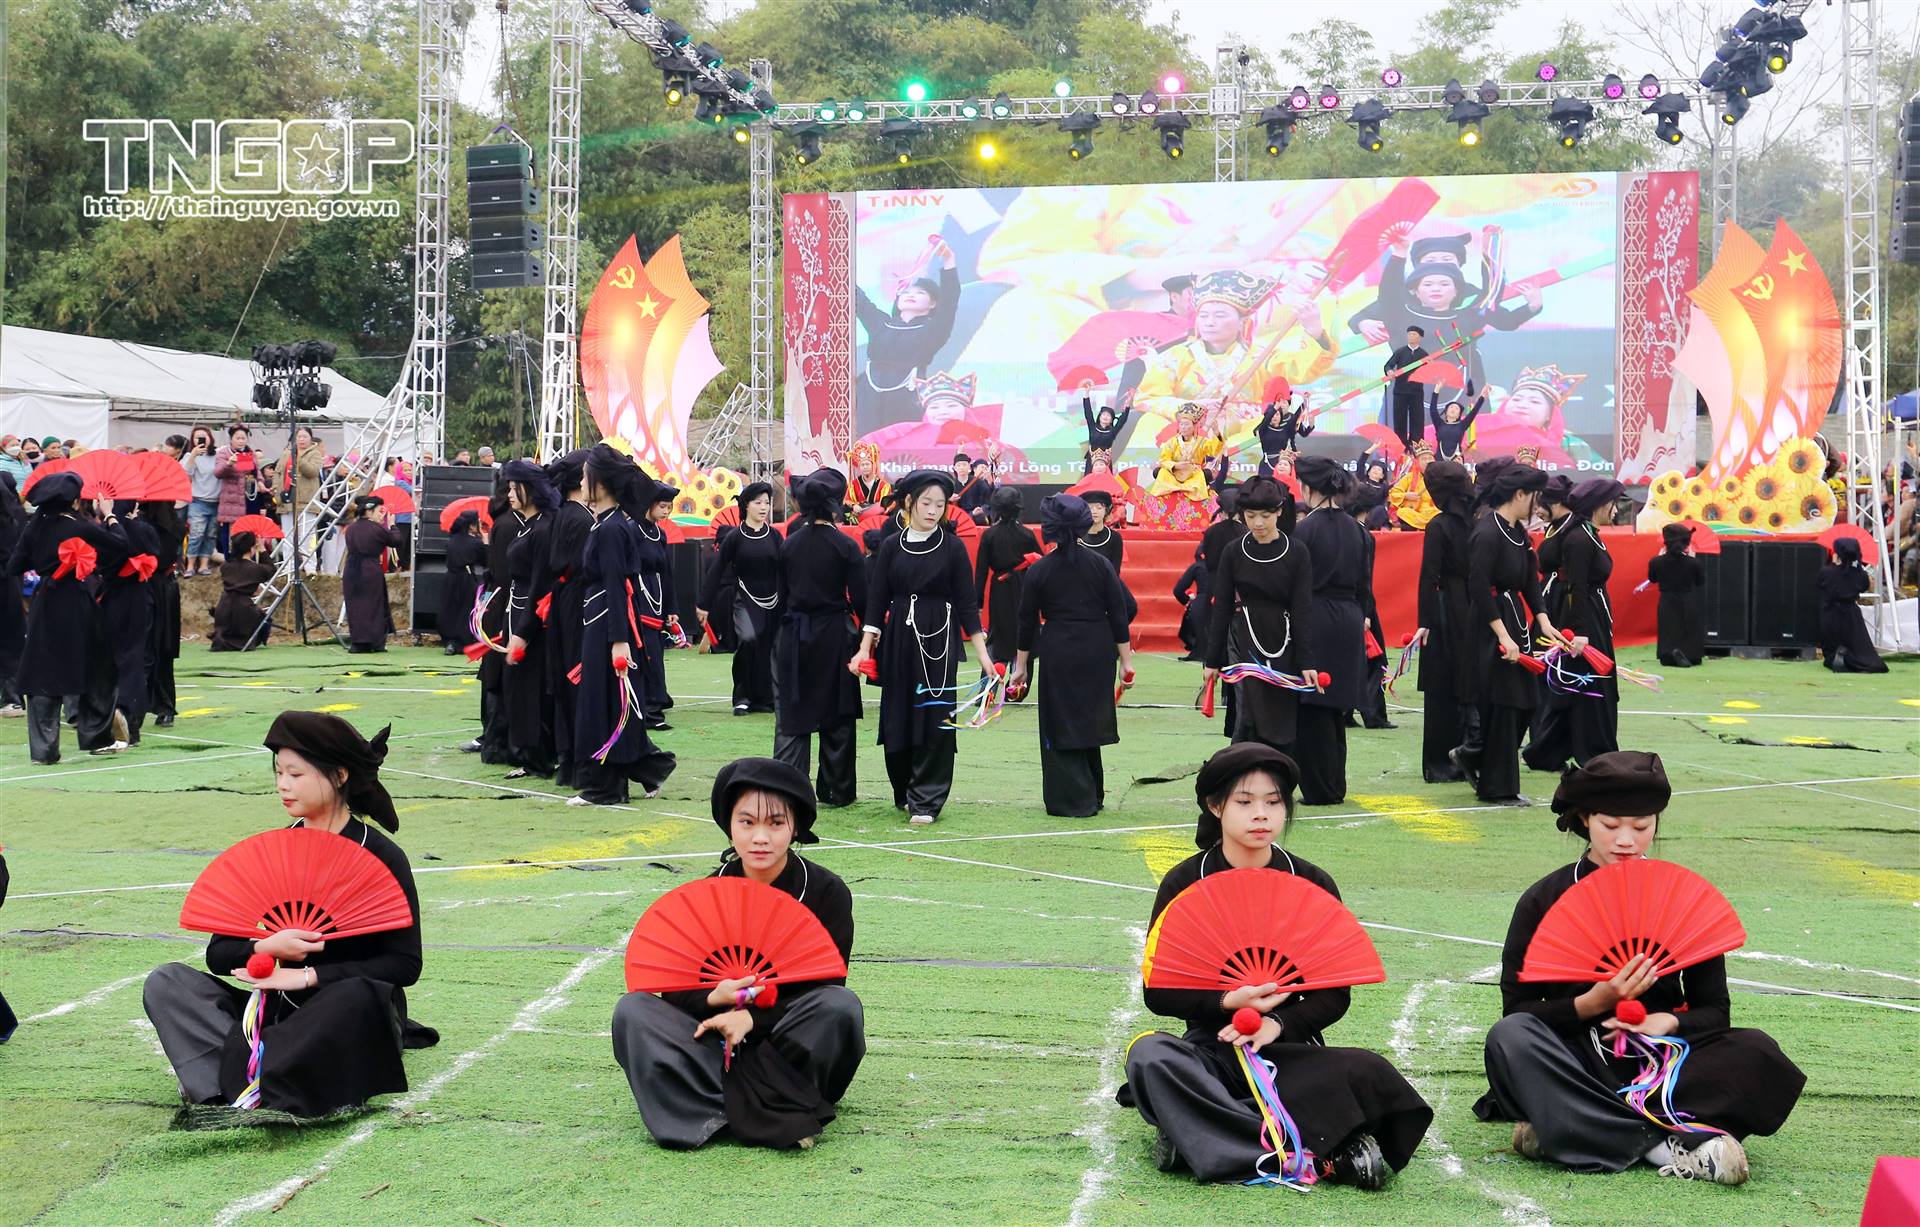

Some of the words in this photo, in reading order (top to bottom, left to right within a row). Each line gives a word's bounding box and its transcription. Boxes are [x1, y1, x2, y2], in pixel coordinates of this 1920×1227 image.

[880, 461, 917, 473] Khai
[1019, 460, 1061, 476] Lồng
[1576, 459, 1615, 472] Đơn
